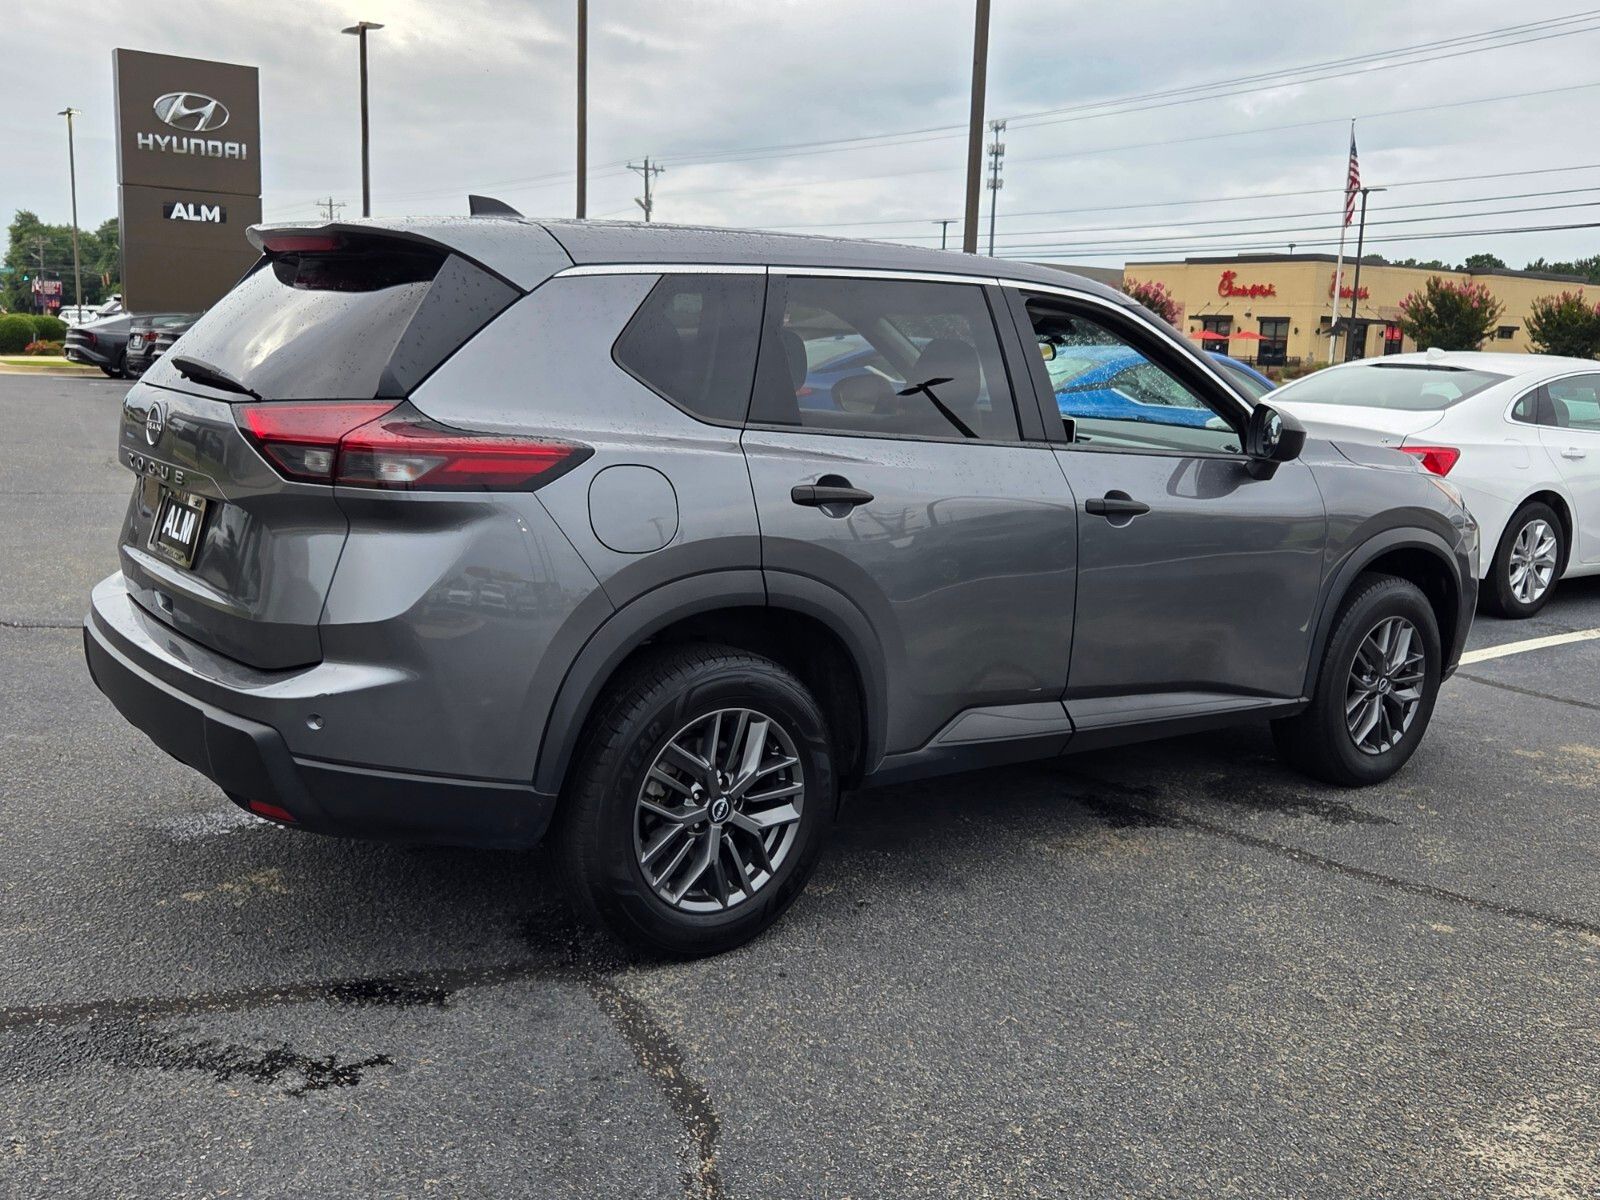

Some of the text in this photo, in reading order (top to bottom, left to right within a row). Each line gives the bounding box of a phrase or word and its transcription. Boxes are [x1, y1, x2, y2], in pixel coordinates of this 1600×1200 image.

[137, 132, 247, 160] HYUNDAI
[170, 202, 221, 223] ALM
[128, 452, 184, 485] ROGUE
[162, 505, 196, 544] ALM
